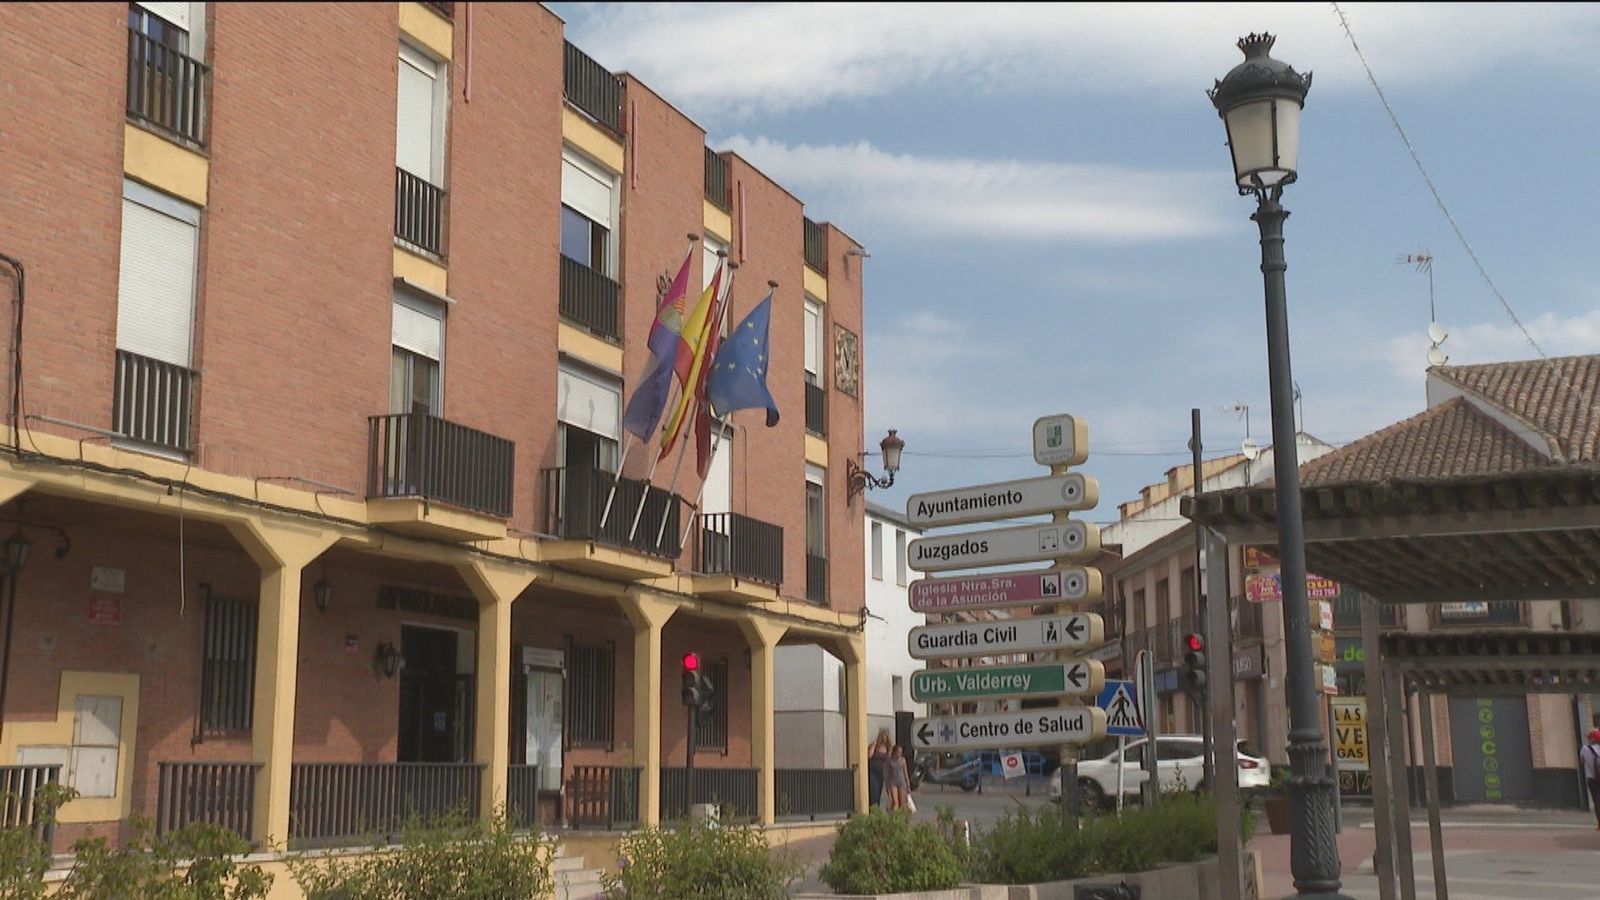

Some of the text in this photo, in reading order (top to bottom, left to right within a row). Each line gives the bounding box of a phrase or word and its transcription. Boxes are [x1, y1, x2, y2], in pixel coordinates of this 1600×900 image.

[917, 490, 1023, 518] Ayuntamiento
[917, 539, 989, 561] Juzgados
[917, 592, 1008, 607] de la Asunción
[917, 626, 1018, 650] Guardia Civil
[919, 671, 1032, 693] Urb. Valderrey
[1334, 708, 1361, 721] LAS
[960, 714, 1084, 738] Centro de Salud
[1336, 728, 1363, 745] VE
[1337, 748, 1364, 759] GAS
